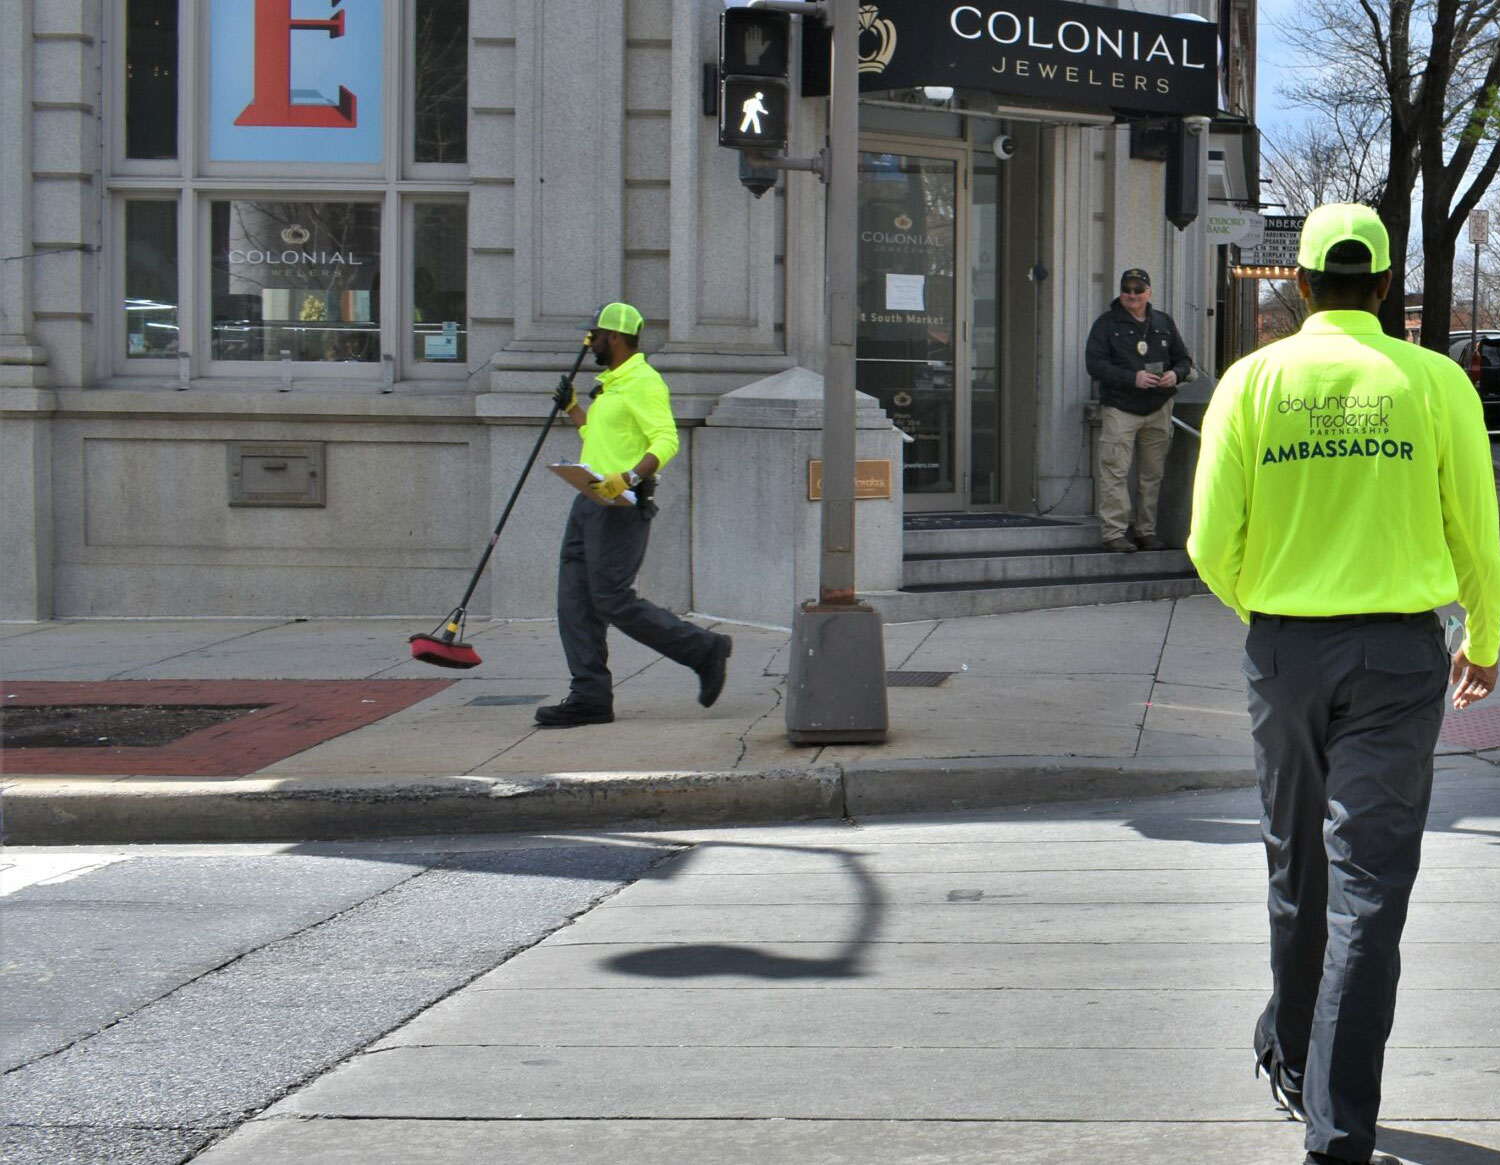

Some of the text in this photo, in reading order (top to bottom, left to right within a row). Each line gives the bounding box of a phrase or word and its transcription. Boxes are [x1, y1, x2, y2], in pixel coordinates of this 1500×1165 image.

[950, 5, 1206, 69] COLONIAL
[991, 56, 1171, 94] JEWELERS
[862, 231, 945, 247] COLONIAL
[229, 250, 363, 265] COLONIAL
[871, 312, 903, 323] South
[906, 314, 944, 325] Market
[1278, 394, 1393, 414] downtown
[1309, 408, 1388, 428] frederick
[1310, 427, 1390, 436] PARTNERSHIP
[1262, 438, 1414, 465] AMBASSADOR
